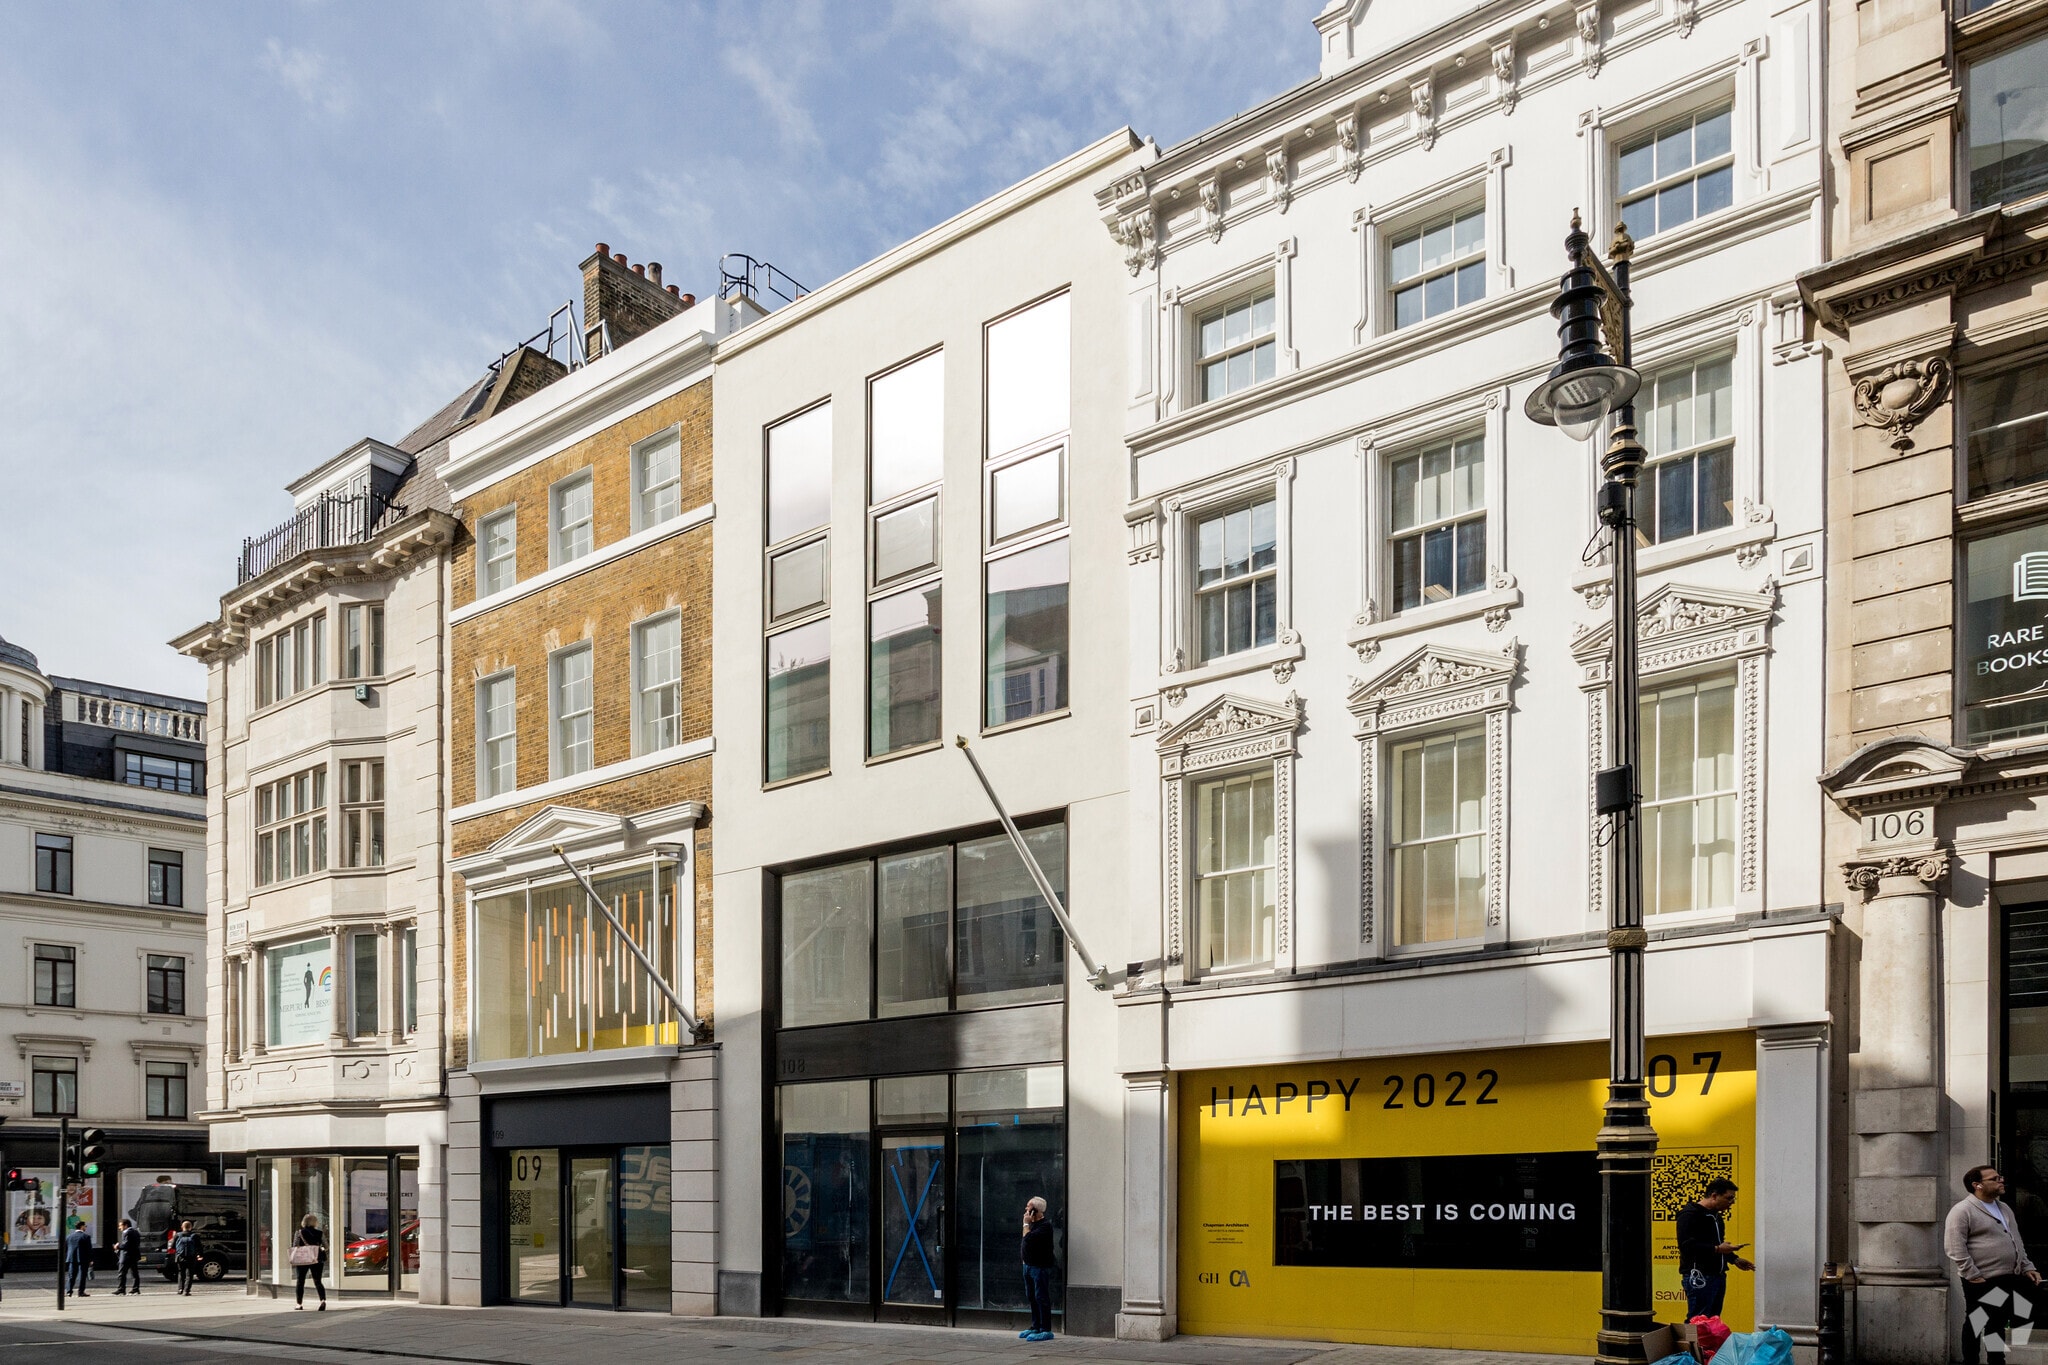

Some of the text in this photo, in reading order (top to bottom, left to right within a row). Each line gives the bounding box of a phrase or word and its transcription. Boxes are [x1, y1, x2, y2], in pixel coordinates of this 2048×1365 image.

[1987, 624, 2044, 649] RARE
[1870, 810, 1925, 842] 106
[782, 1057, 806, 1074] 108
[1648, 1050, 1722, 1098] 07
[1211, 1069, 1499, 1118] HAPPY 2022
[1309, 1203, 1576, 1221] THE BEST IS COMING
[1198, 1269, 1251, 1287] GH CA
